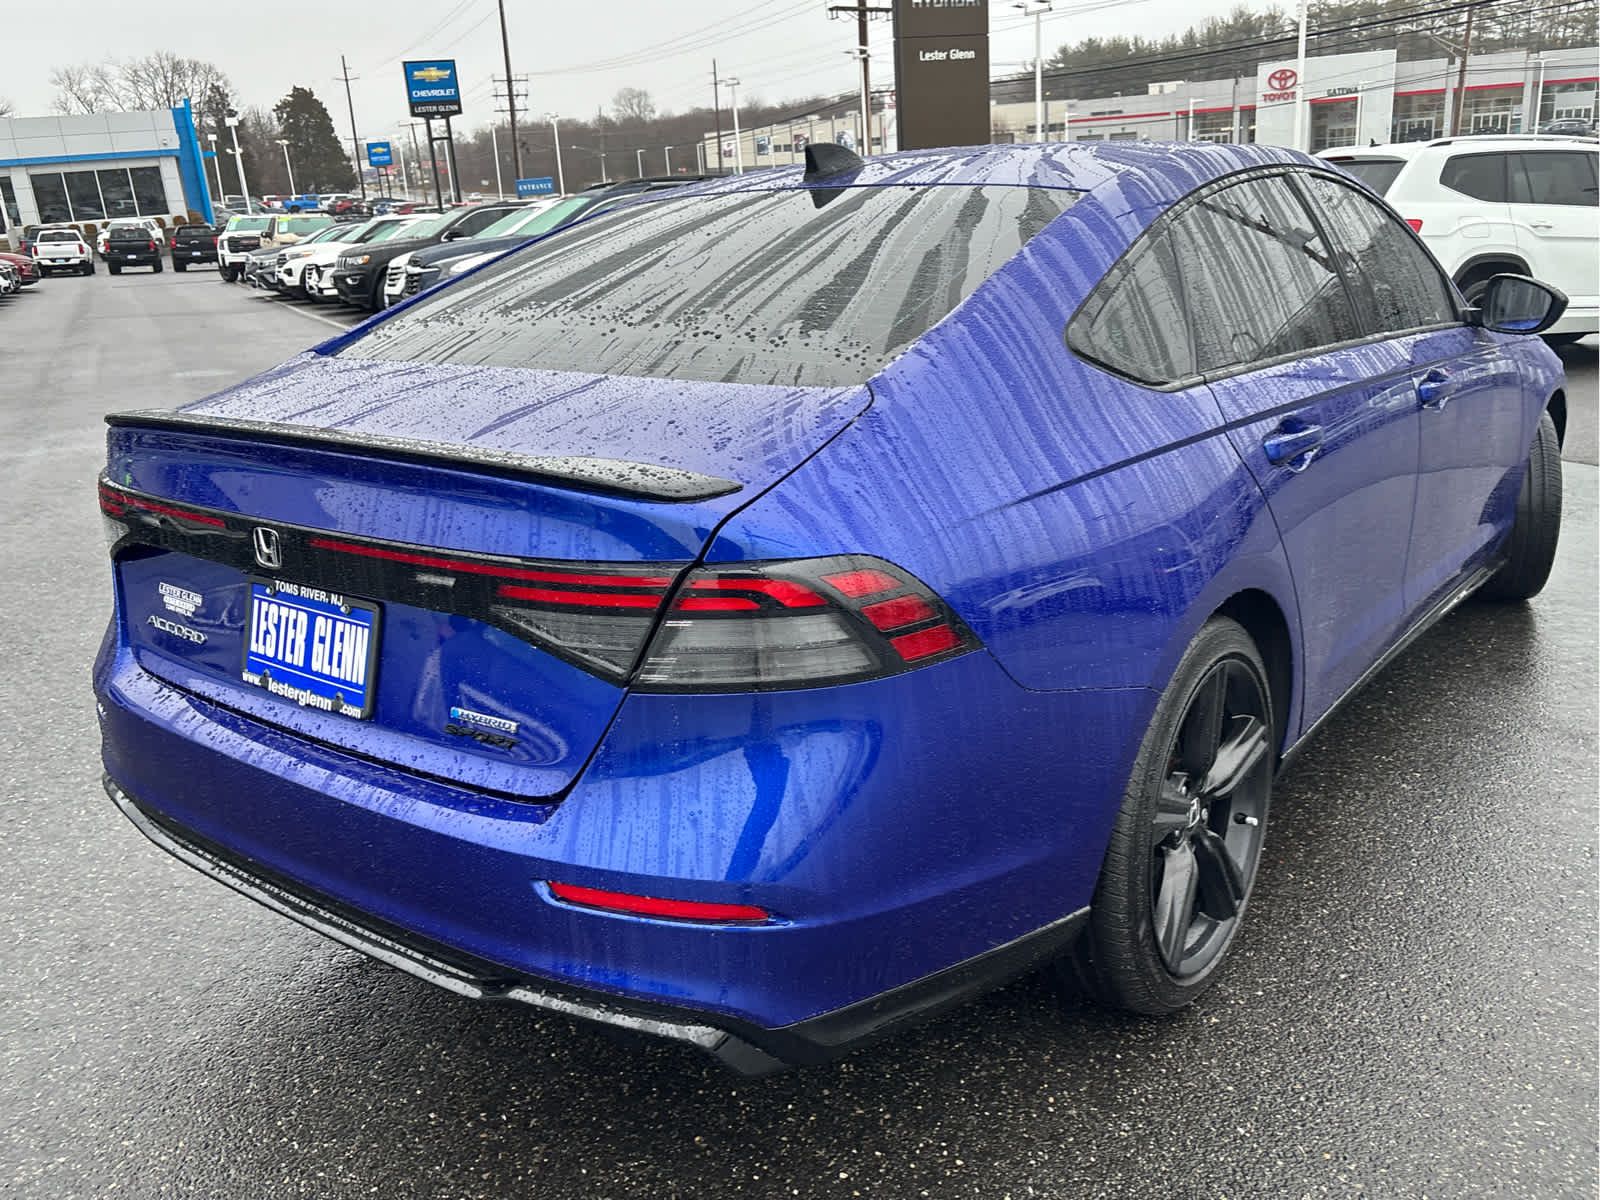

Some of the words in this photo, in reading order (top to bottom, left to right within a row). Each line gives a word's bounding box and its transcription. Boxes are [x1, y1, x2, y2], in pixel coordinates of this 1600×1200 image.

[919, 50, 948, 61] Lester
[949, 49, 976, 60] Glenn
[412, 88, 456, 97] CHEVROLET
[1261, 91, 1297, 102] TOYOT
[1326, 87, 1360, 97] GATEWA
[414, 105, 437, 113] LESTER
[438, 104, 459, 112] GLENN
[518, 182, 553, 191] ENTRANCE
[160, 584, 181, 599] LESTER
[274, 580, 300, 596] TOMS
[300, 586, 329, 603] RIVER,
[330, 593, 344, 606] NJ
[146, 615, 208, 645] ACCORD
[250, 599, 308, 668] LESTER
[311, 615, 369, 686] GLENN
[267, 677, 332, 711] lesterglenn
[461, 711, 513, 731] HYBRID
[443, 723, 521, 751] SPORT
